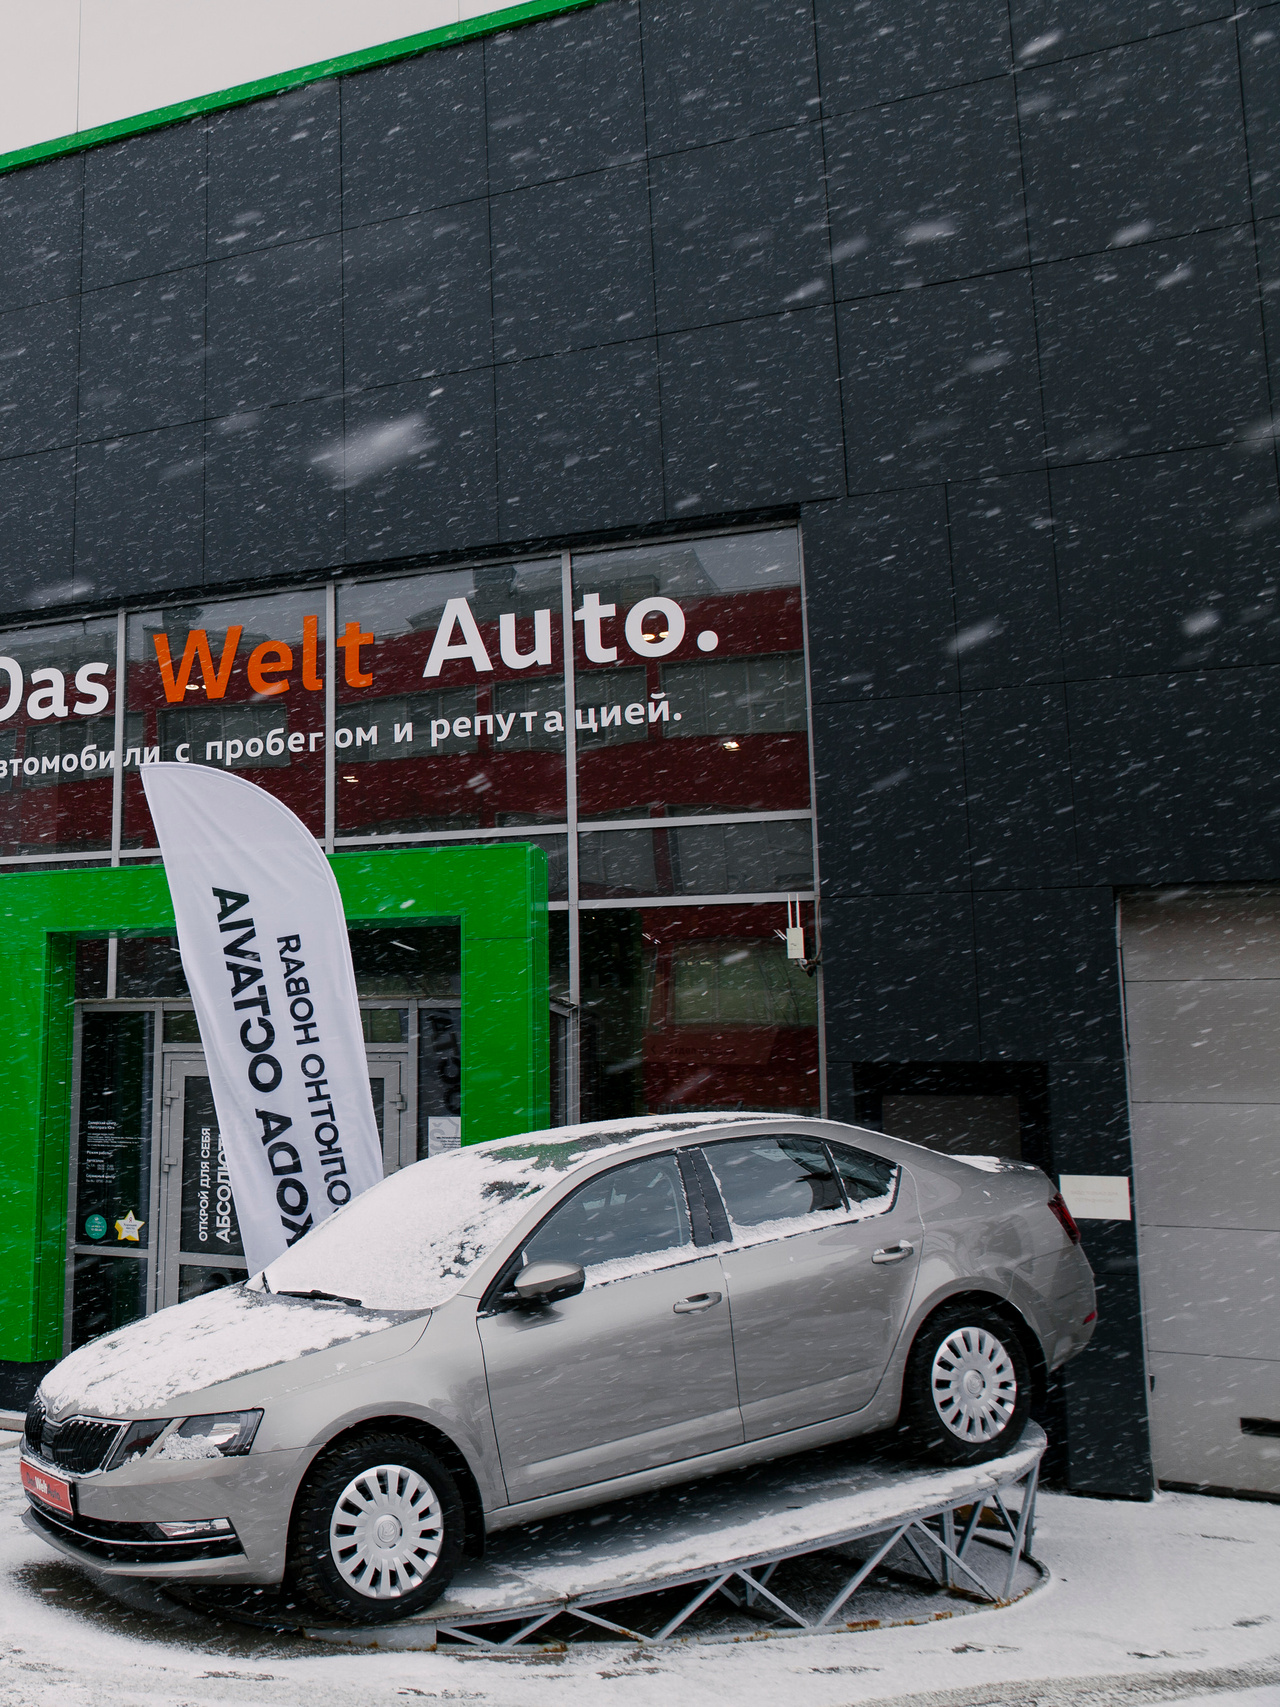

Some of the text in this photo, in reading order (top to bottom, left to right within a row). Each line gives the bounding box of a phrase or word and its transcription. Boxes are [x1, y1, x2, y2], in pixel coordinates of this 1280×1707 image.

[153, 614, 375, 703] Welt
[422, 592, 719, 678] Auto.
[175, 741, 190, 763] с
[206, 727, 378, 766] пробегом
[393, 722, 413, 743] и
[431, 692, 683, 747] репутацией.
[197, 1127, 211, 1242] ОТКРОЙ ДЛЯ СЕБЯ
